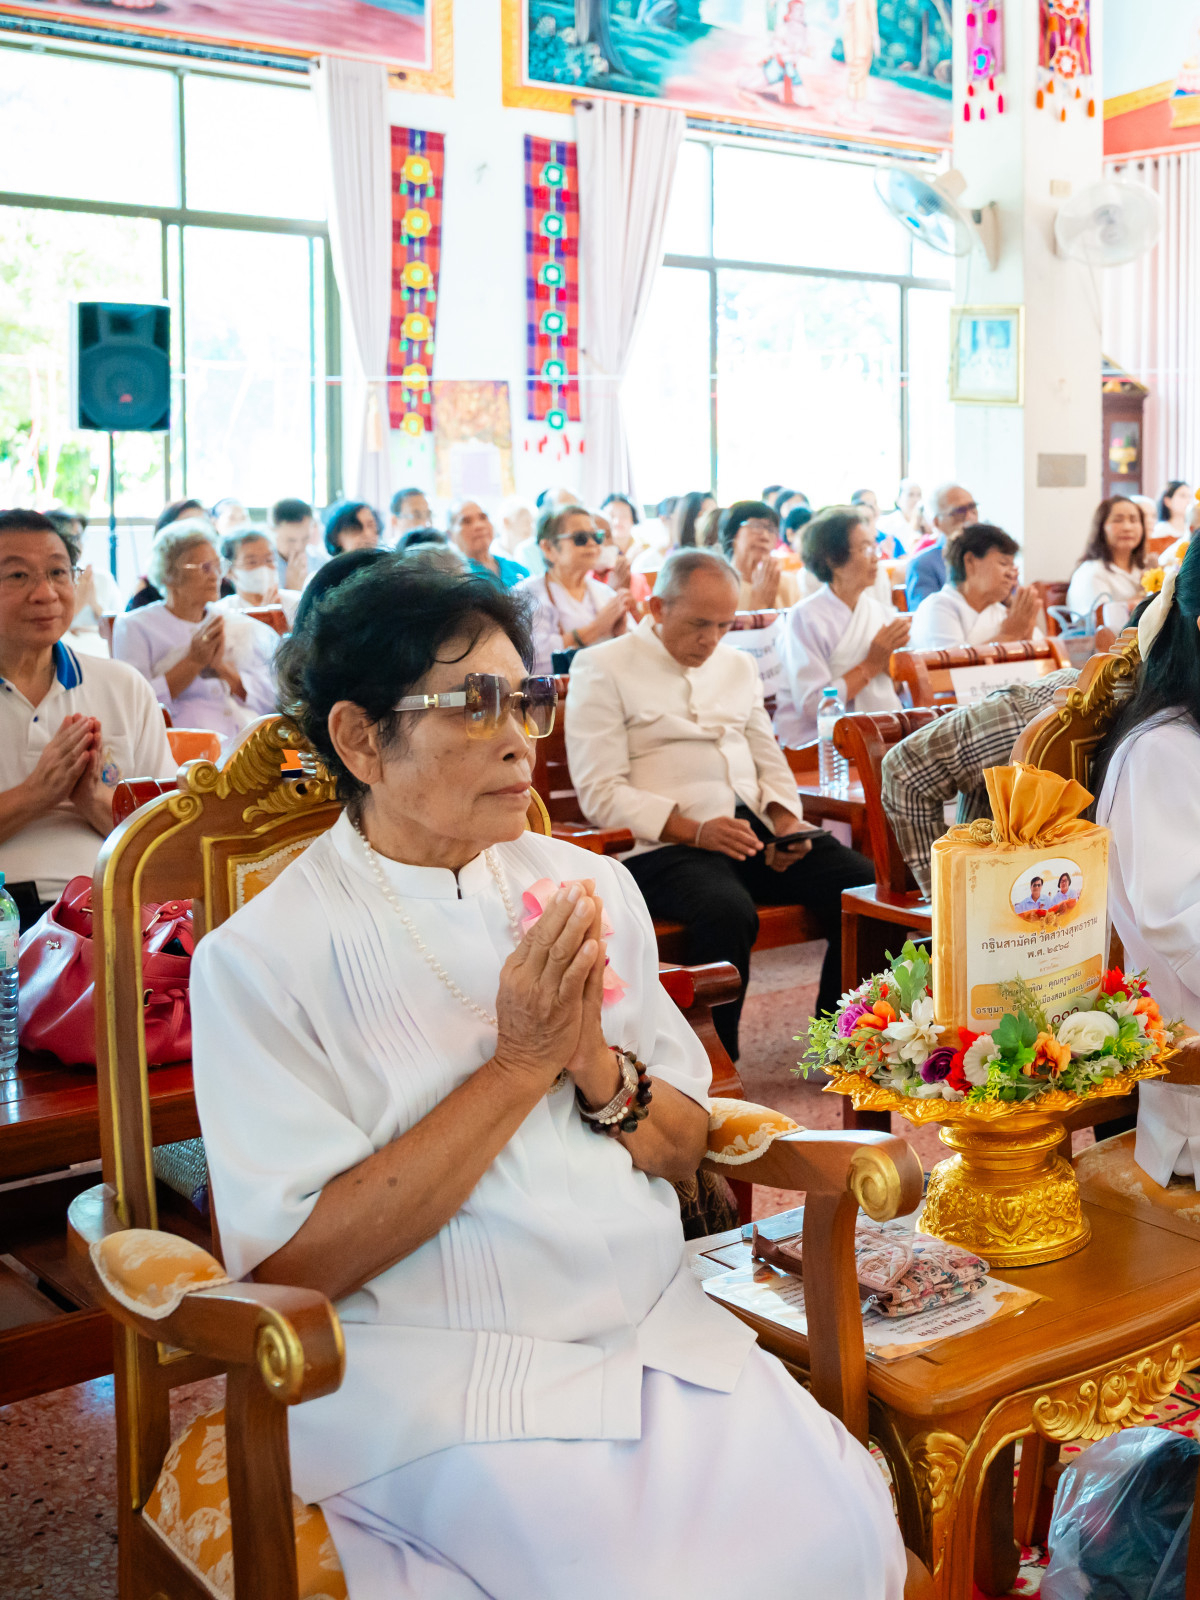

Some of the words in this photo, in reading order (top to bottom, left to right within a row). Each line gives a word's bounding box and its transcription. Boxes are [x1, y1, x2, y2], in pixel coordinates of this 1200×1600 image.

[981, 932, 1037, 953] กฐินสามัคคี
[1027, 948, 1045, 959] พ.ศ.
